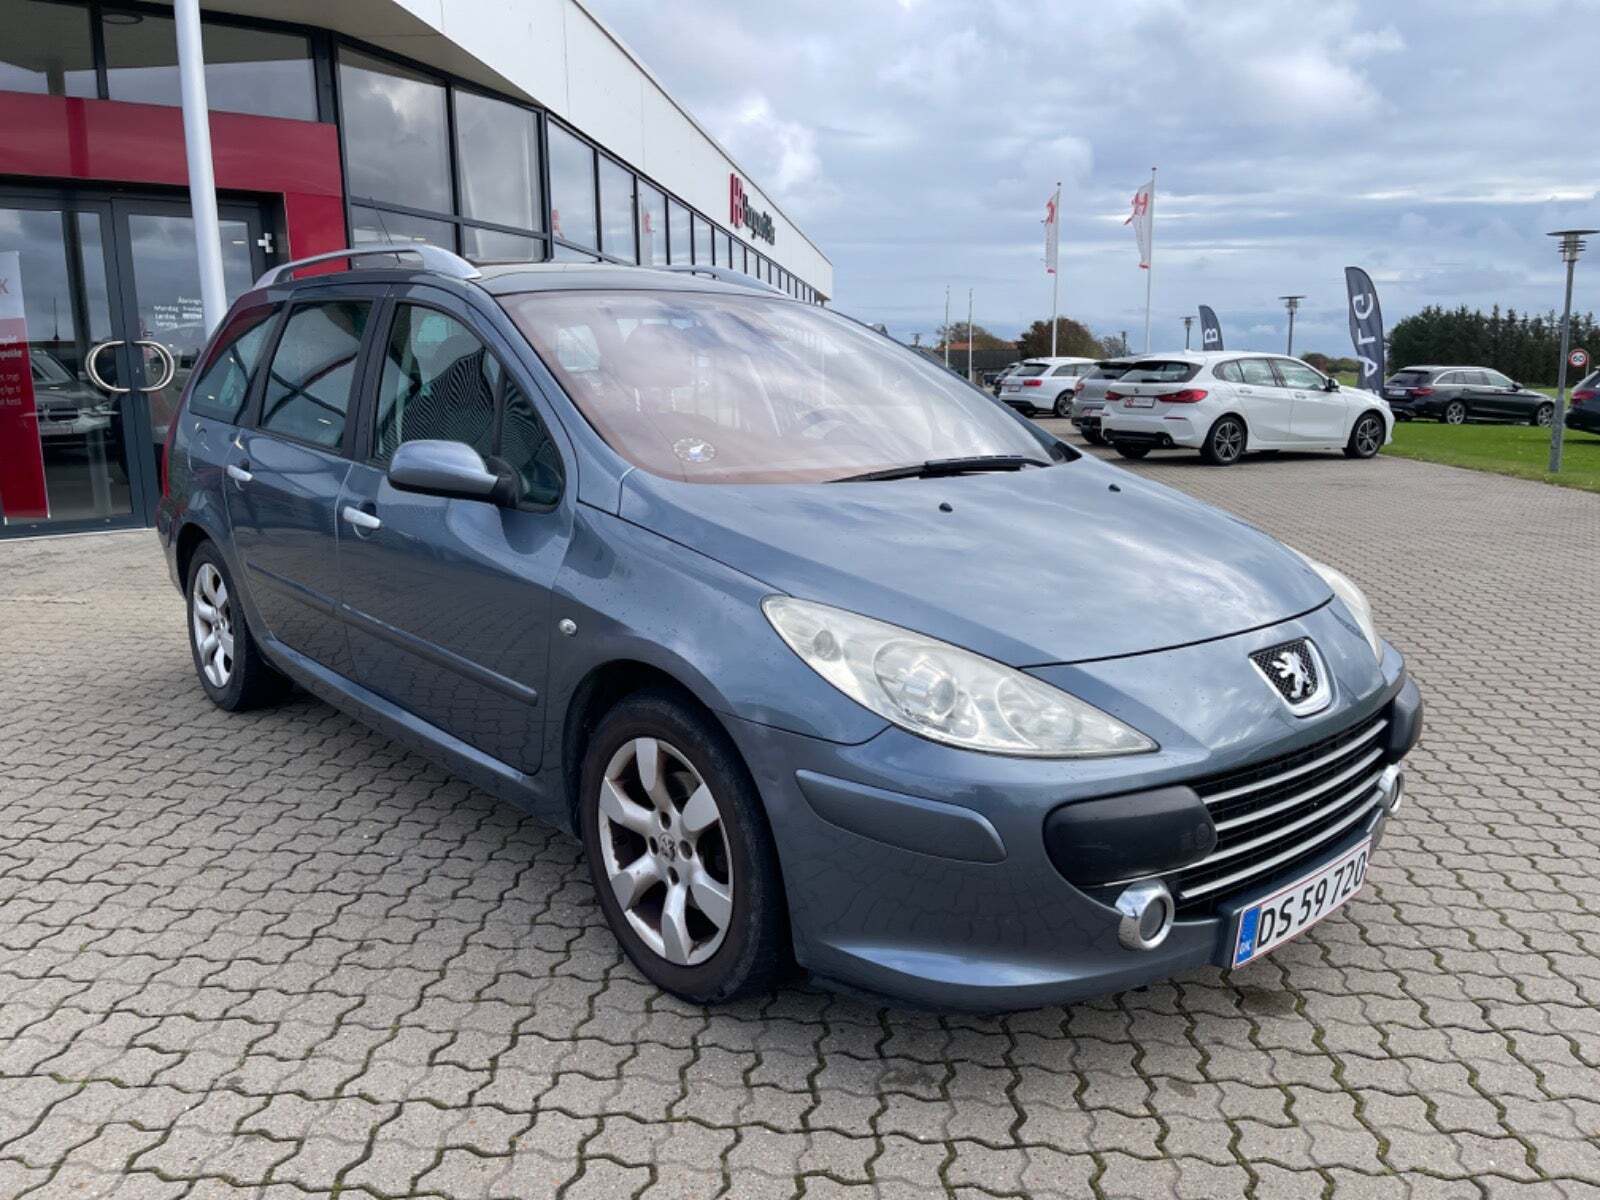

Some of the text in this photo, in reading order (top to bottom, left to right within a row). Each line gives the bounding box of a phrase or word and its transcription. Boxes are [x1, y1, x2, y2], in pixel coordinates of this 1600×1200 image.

[1257, 850, 1367, 948] DS 59 720
